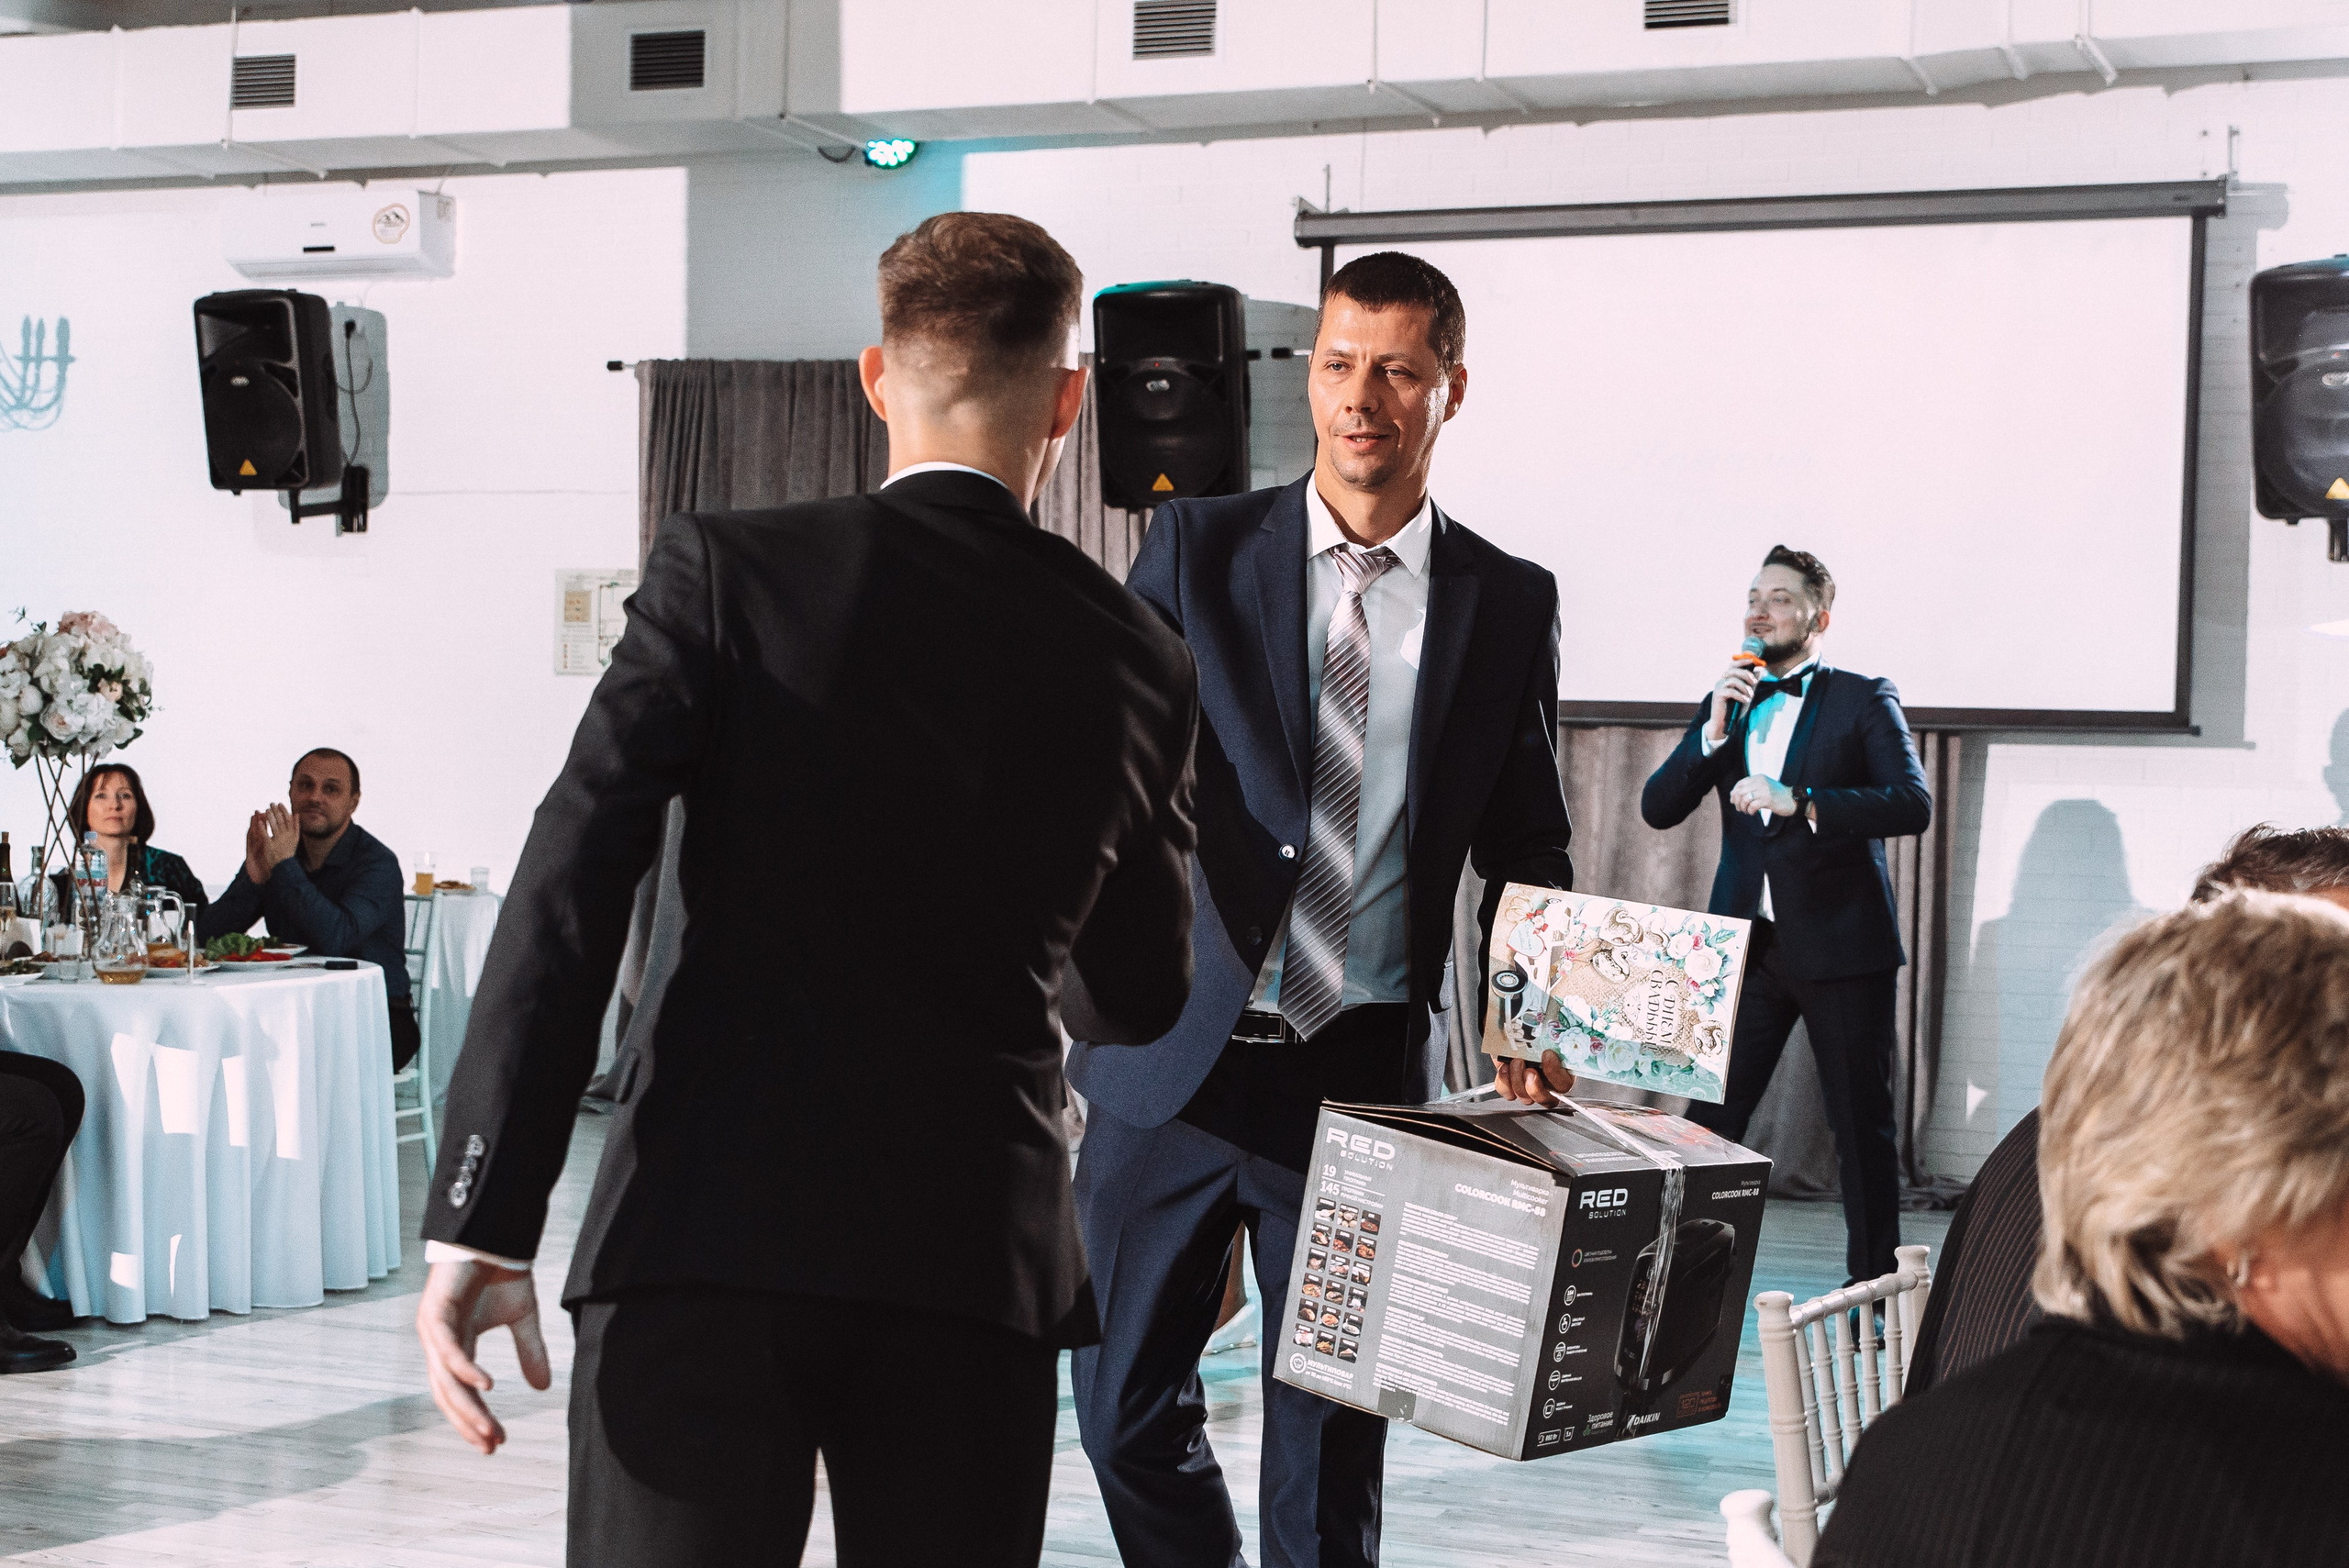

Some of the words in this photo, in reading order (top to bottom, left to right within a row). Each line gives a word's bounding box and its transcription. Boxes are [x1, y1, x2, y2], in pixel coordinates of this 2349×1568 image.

[1325, 1127, 1396, 1161] RED
[1340, 1149, 1394, 1171] SOLUTION
[1322, 1163, 1337, 1177] 19
[1319, 1180, 1341, 1196] 145
[1454, 1183, 1511, 1207] COLORCOOK
[1711, 1189, 1742, 1200] COLORCOOK
[1579, 1187, 1629, 1209] RED
[1588, 1208, 1627, 1219] SOLUTION
[1587, 1411, 1613, 1424] Здоровое
[1633, 1412, 1661, 1426] DAIKIN
